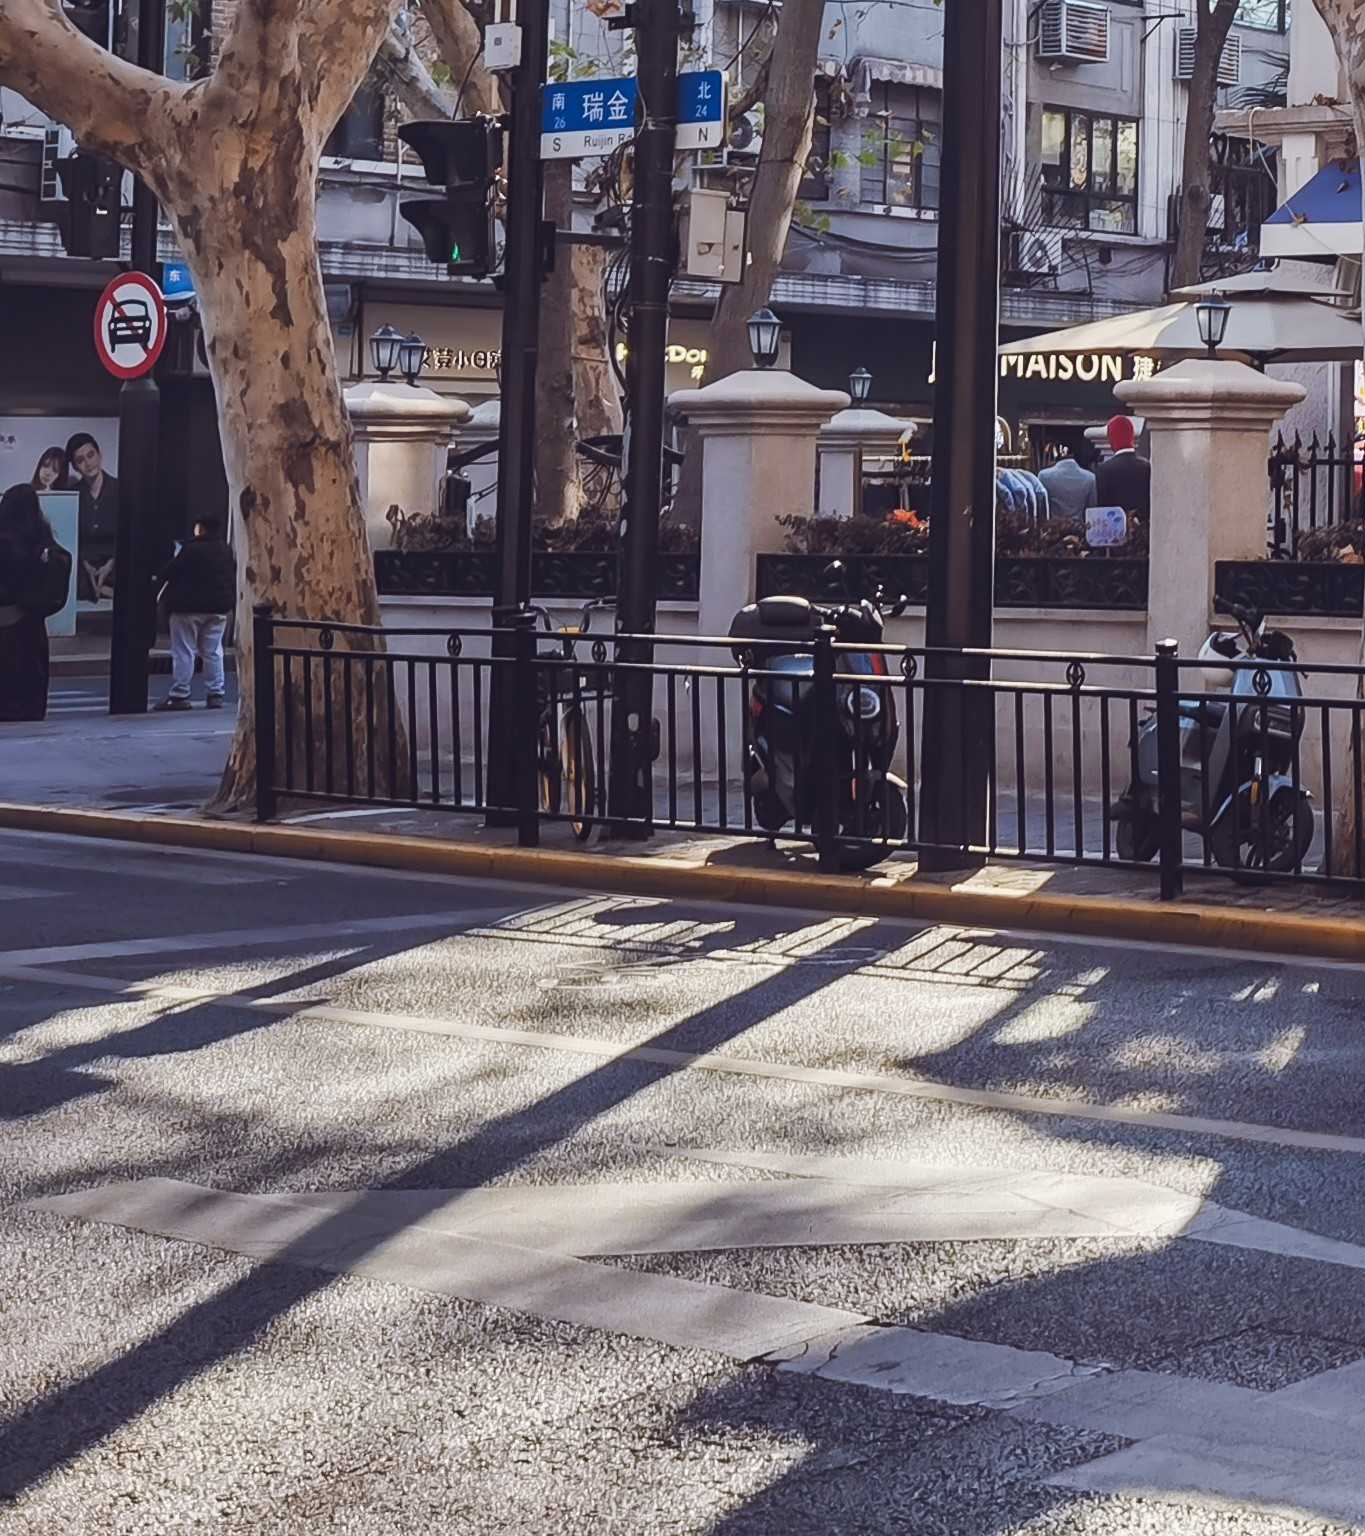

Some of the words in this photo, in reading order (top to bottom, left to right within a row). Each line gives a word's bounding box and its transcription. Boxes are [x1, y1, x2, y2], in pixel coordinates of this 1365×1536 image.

[552, 93, 565, 111] 南
[582, 90, 634, 122] 瑞金
[698, 81, 711, 100] 北
[554, 117, 566, 129] 26
[695, 105, 707, 117] 24
[552, 137, 561, 152] S
[584, 135, 613, 150] Ruijin
[698, 128, 708, 142] N
[1000, 353, 1122, 382] MAISON
